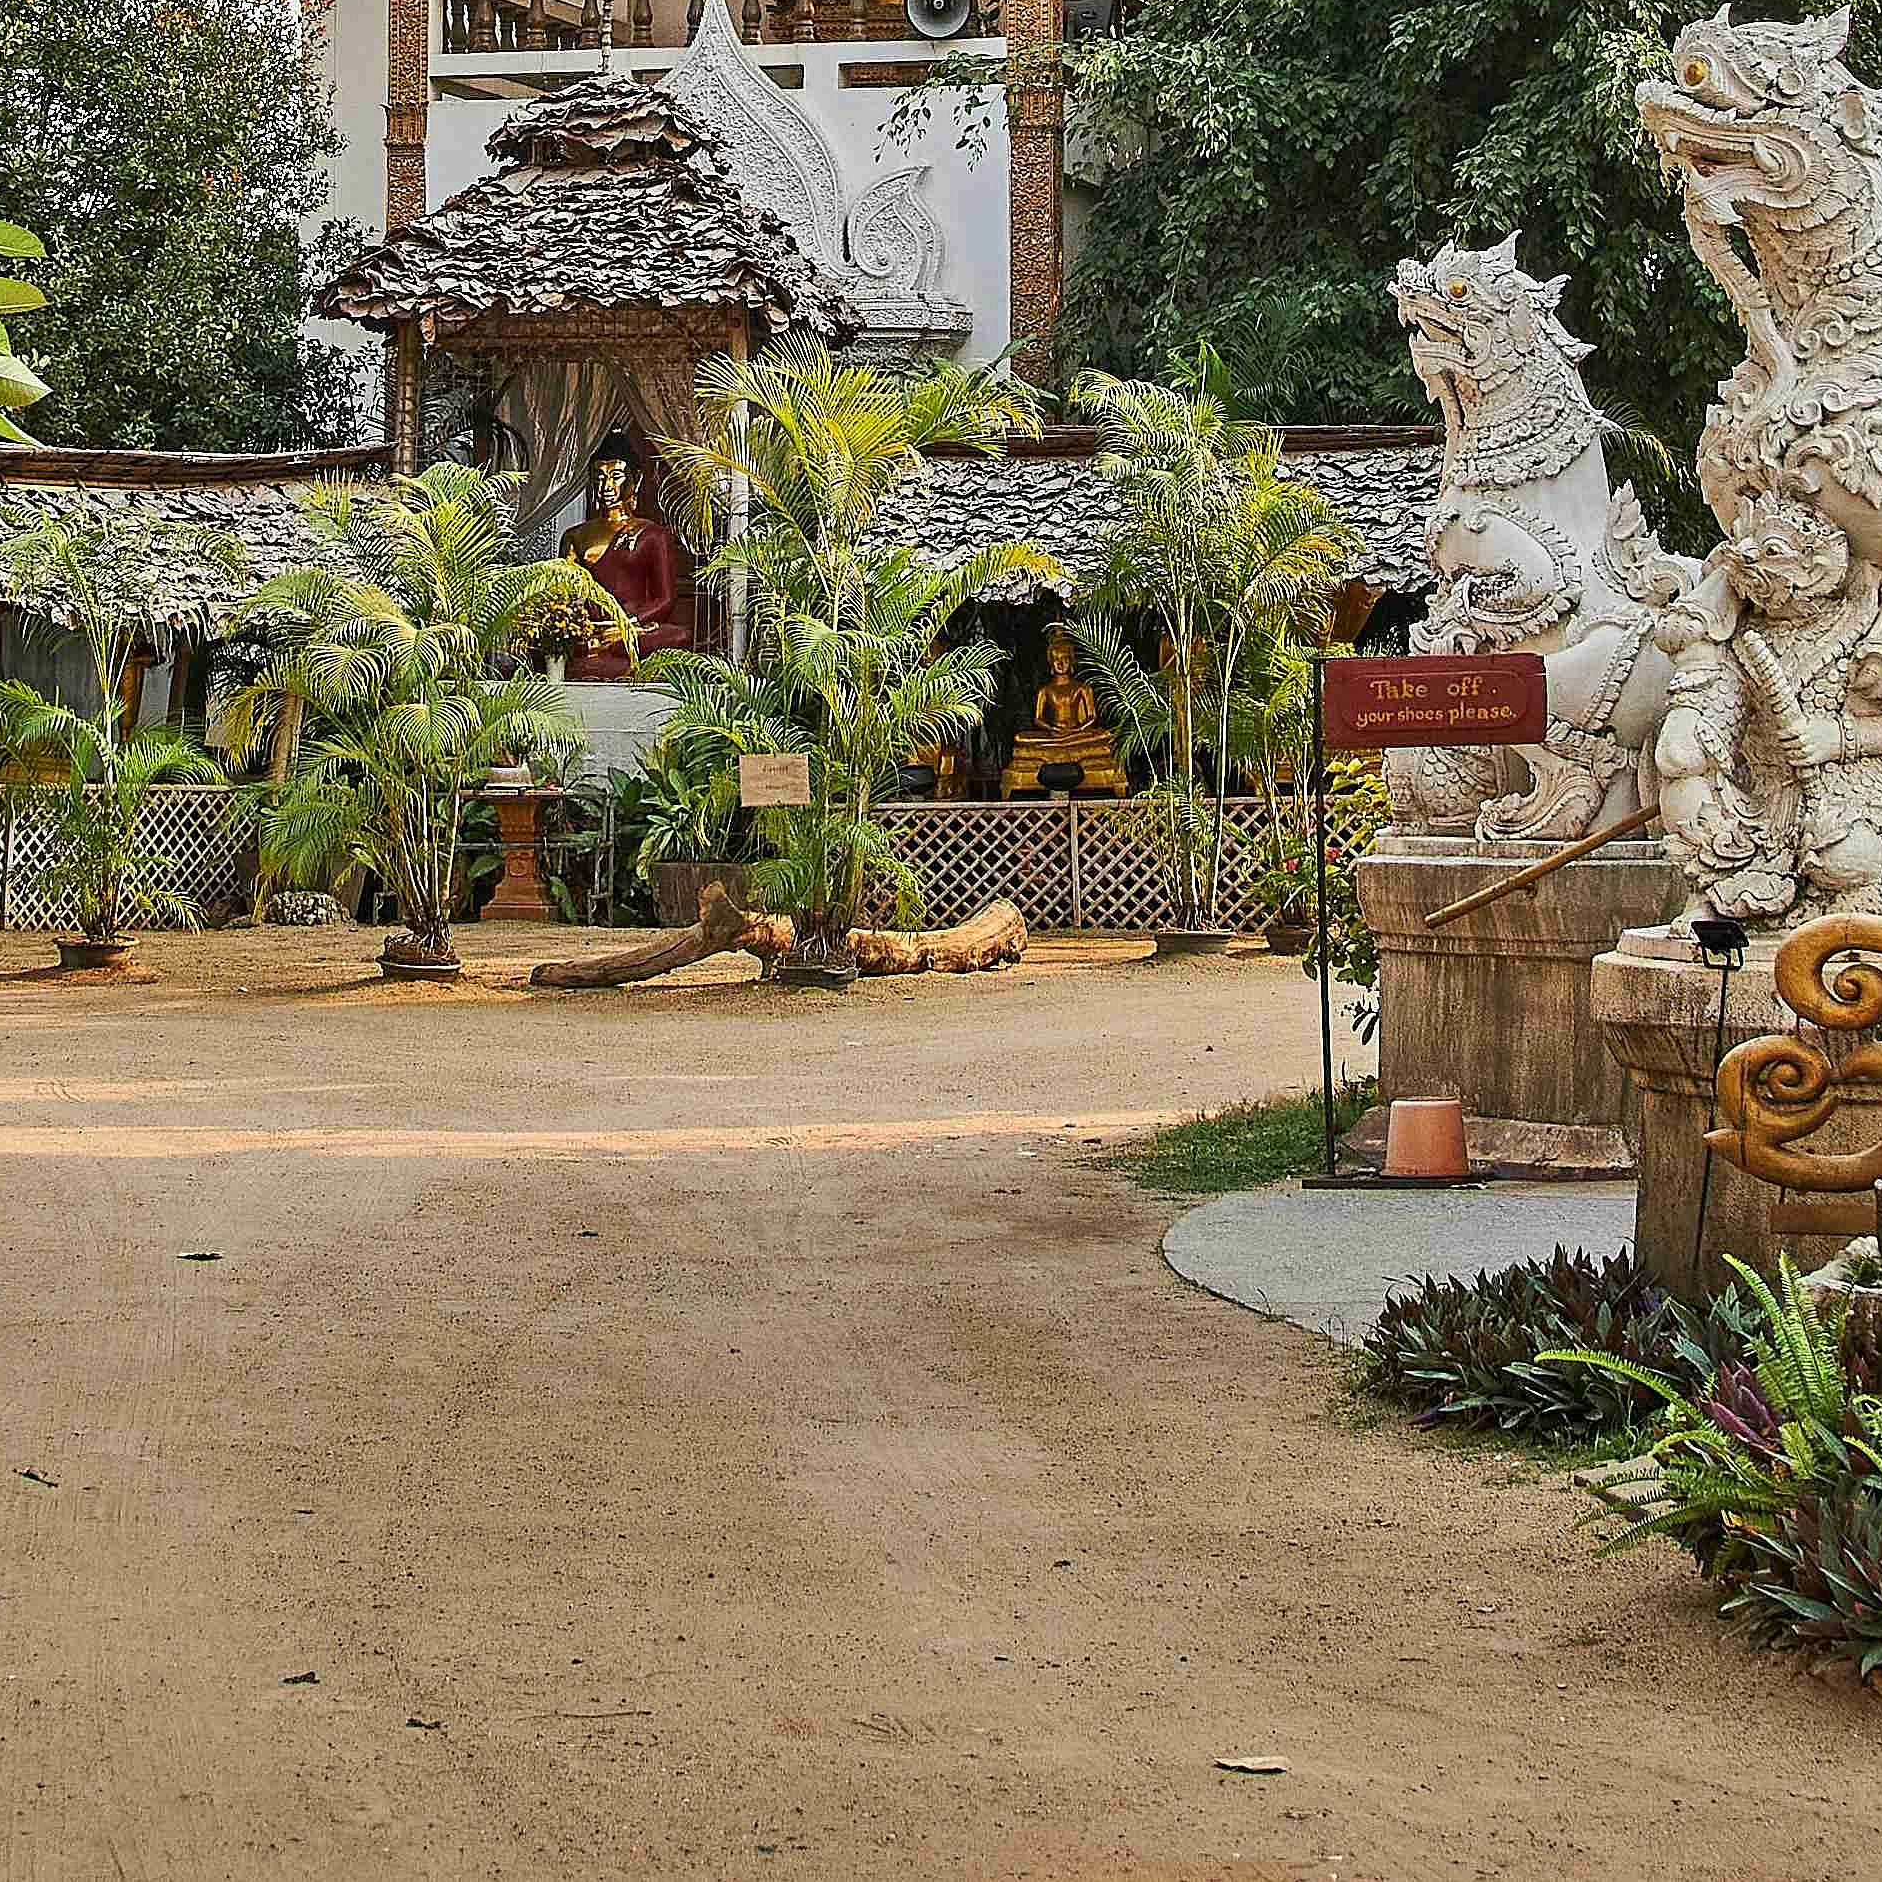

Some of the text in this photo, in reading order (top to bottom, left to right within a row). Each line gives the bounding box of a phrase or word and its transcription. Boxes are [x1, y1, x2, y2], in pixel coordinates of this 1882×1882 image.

[1368, 678, 1430, 699] Take
[1355, 712, 1395, 728] your
[1397, 706, 1444, 722] shoes
